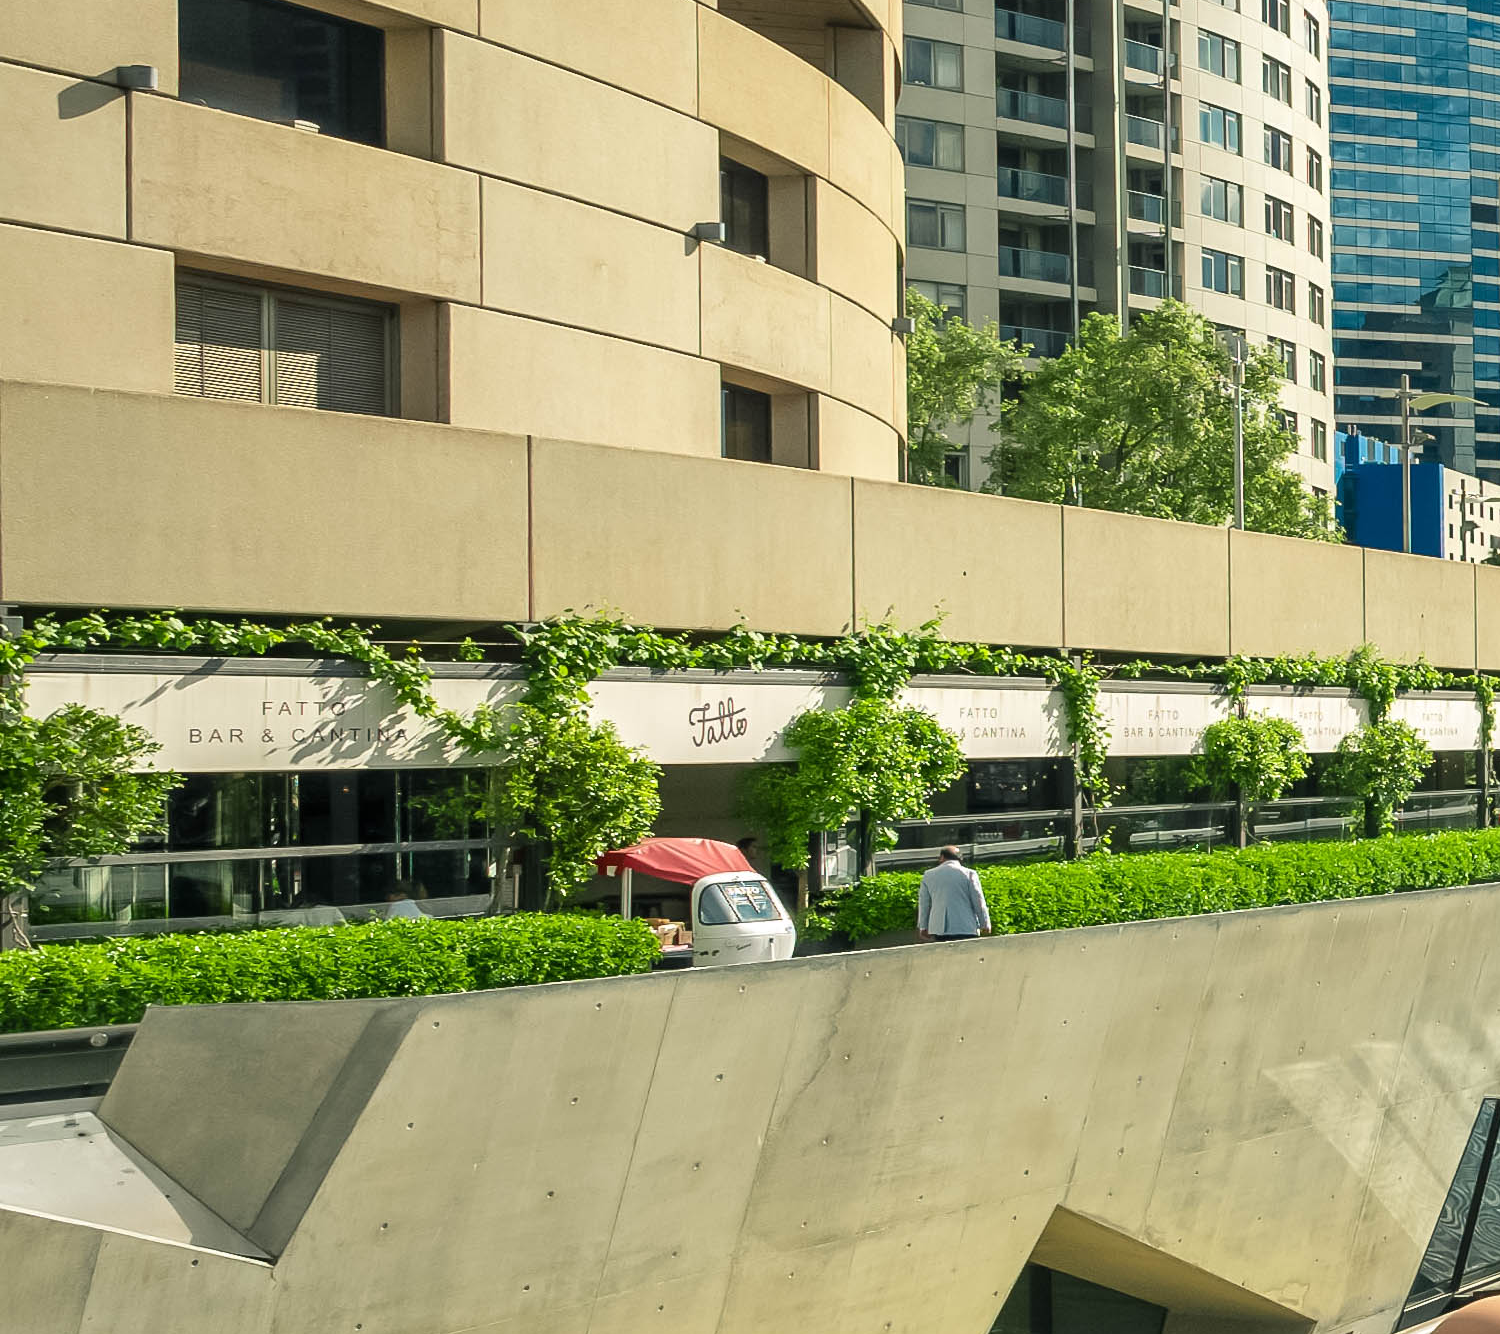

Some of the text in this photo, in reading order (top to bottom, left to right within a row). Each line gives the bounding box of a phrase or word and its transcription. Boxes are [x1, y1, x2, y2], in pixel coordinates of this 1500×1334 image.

[262, 701, 346, 716] FATTO
[959, 707, 998, 719] FATTO
[1148, 709, 1179, 721] FATTO
[689, 696, 749, 747] Fatto
[189, 727, 409, 743] BAR & CANTINA
[973, 727, 1027, 739] CANTINA
[1123, 726, 1144, 738] BAR
